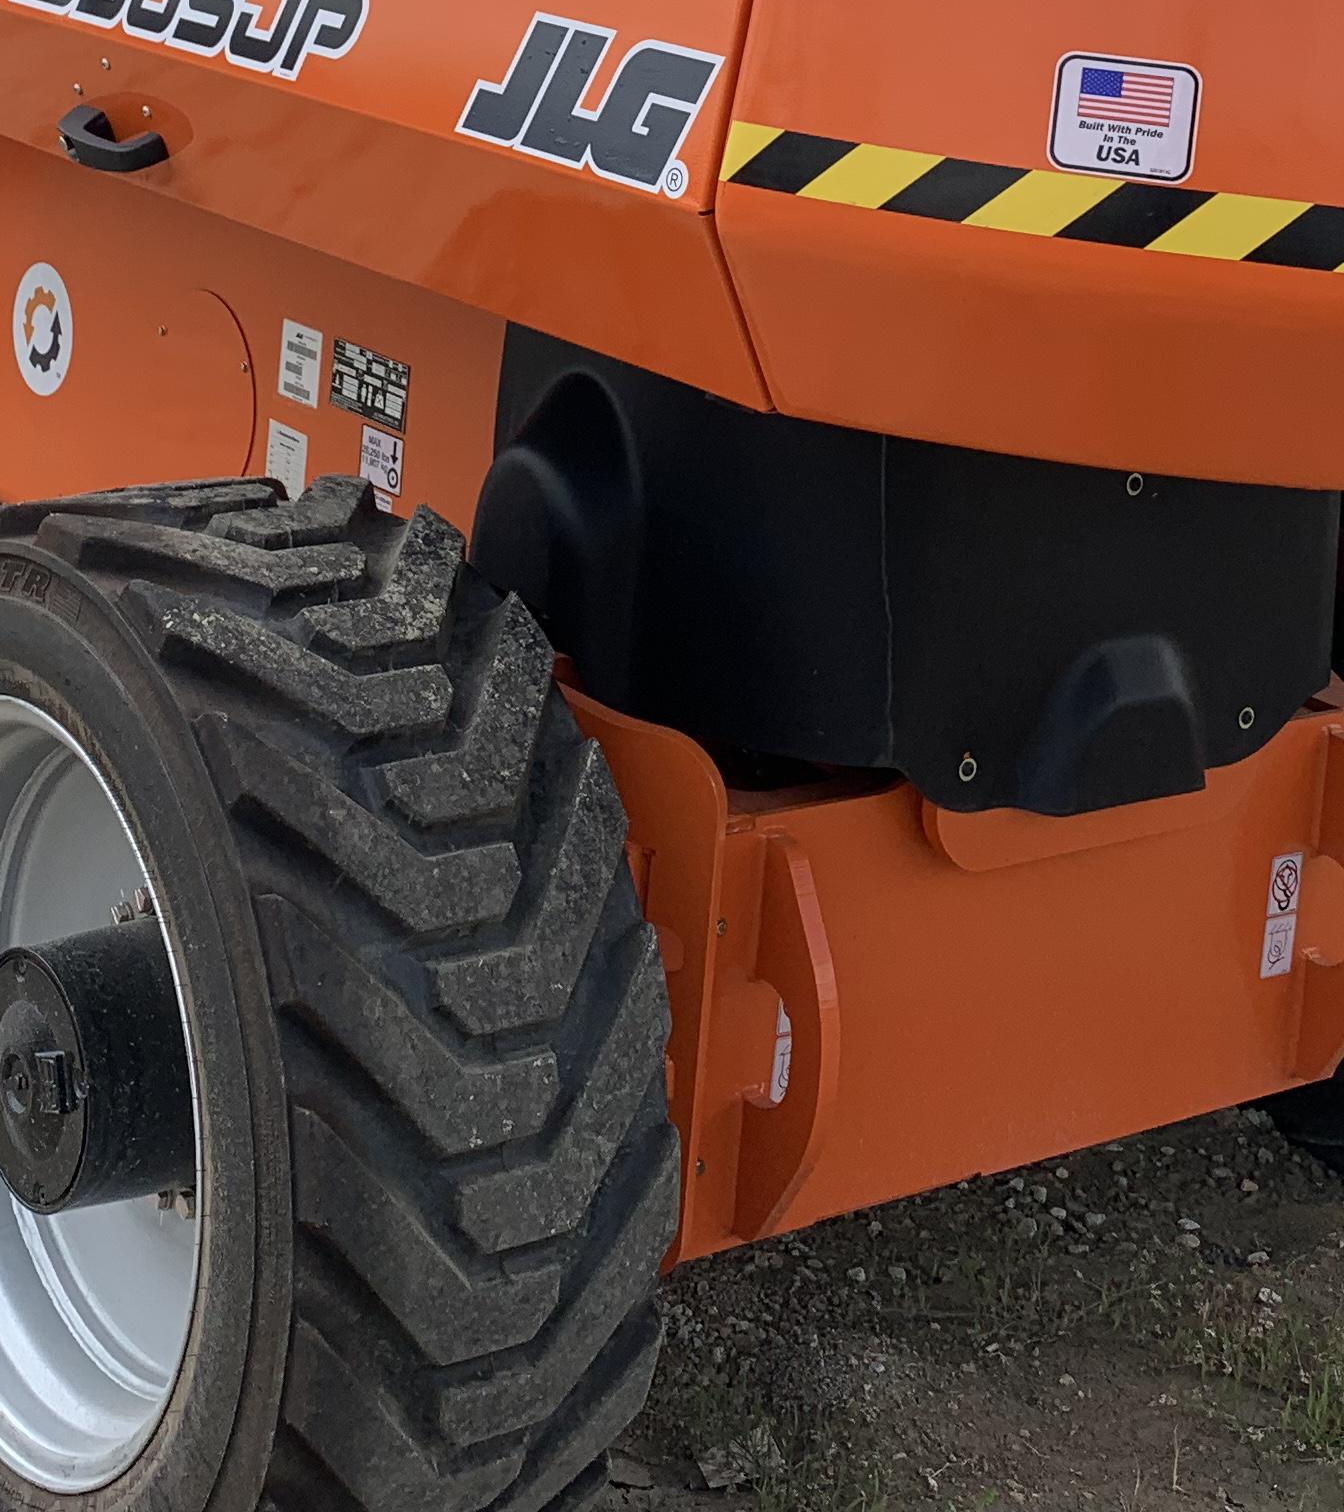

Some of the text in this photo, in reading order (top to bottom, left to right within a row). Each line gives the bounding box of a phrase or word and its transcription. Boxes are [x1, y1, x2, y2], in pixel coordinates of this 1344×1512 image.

[460, 18, 723, 192] JLG
[1078, 120, 1164, 139] Built With Pride
[1102, 134, 1136, 146] In The
[1096, 145, 1140, 166] USA
